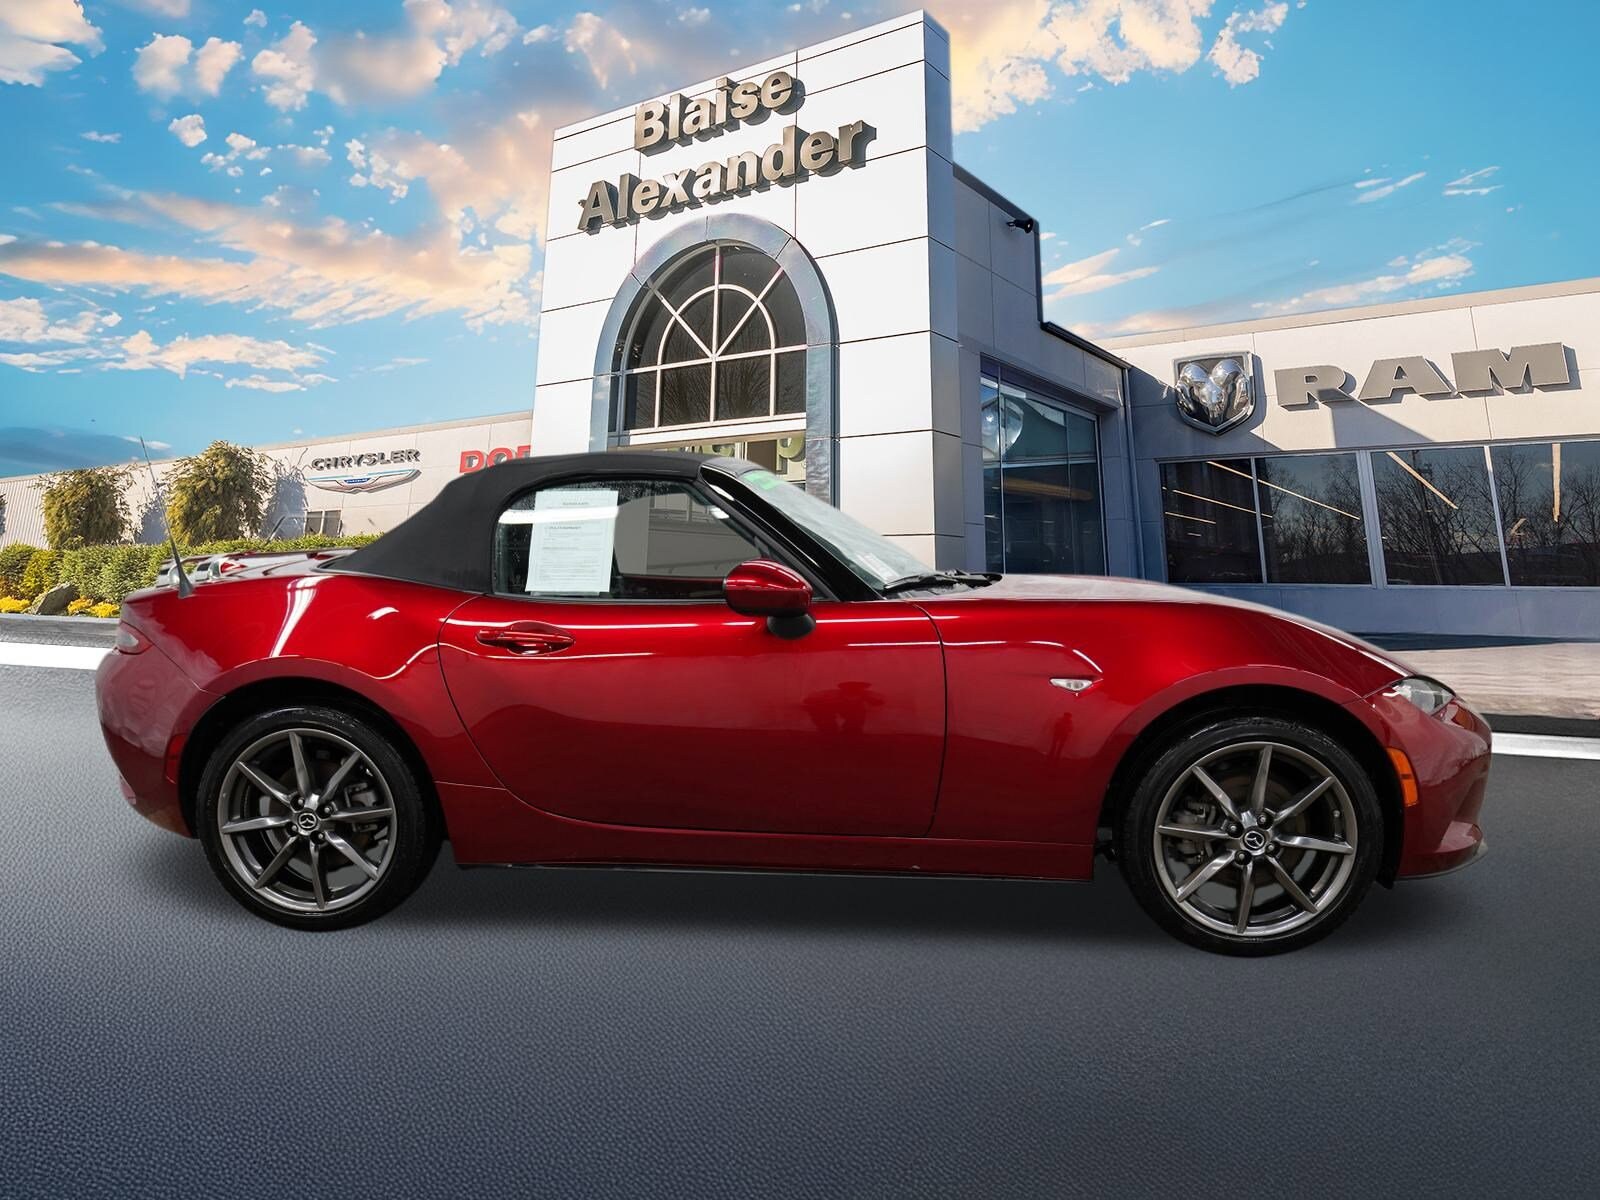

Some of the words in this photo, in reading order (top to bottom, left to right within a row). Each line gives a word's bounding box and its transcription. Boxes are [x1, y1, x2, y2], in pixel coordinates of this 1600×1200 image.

[634, 70, 803, 154] Blaise
[577, 119, 874, 233] Alexander
[1274, 341, 1575, 409] RAM
[311, 449, 420, 471] CHRYSLER
